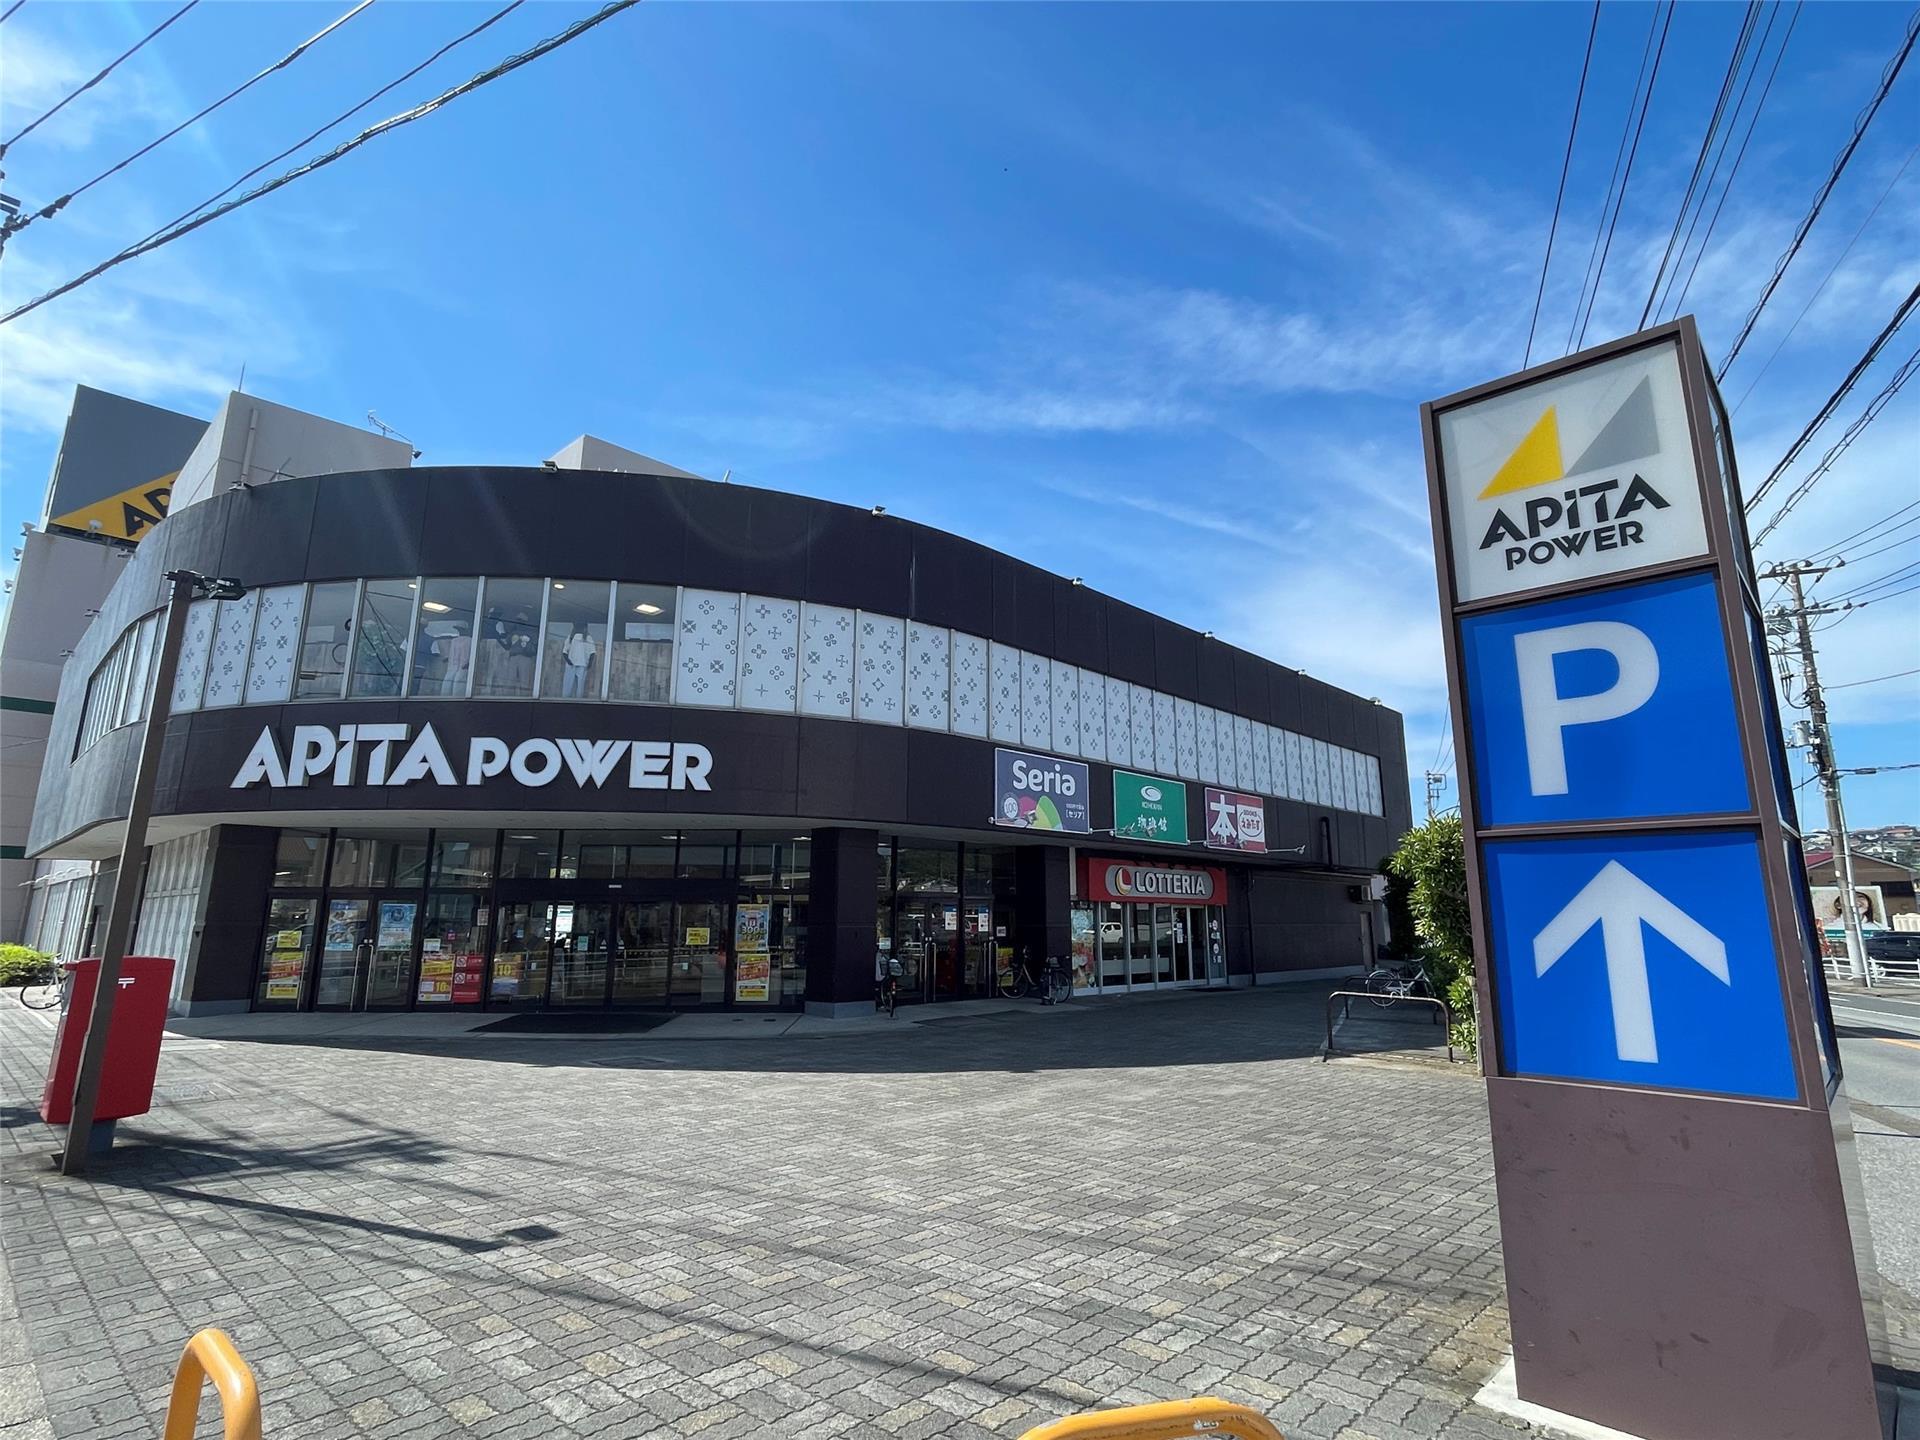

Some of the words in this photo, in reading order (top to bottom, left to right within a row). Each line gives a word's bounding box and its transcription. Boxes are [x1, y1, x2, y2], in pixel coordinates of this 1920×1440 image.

[122, 481, 175, 537] AP
[1505, 520, 1644, 571] POWER
[1514, 621, 1660, 796] P
[466, 736, 714, 792] POWER
[1012, 760, 1076, 796] Seria
[1210, 794, 1238, 845] 本
[1135, 871, 1206, 895] LOTTERIA
